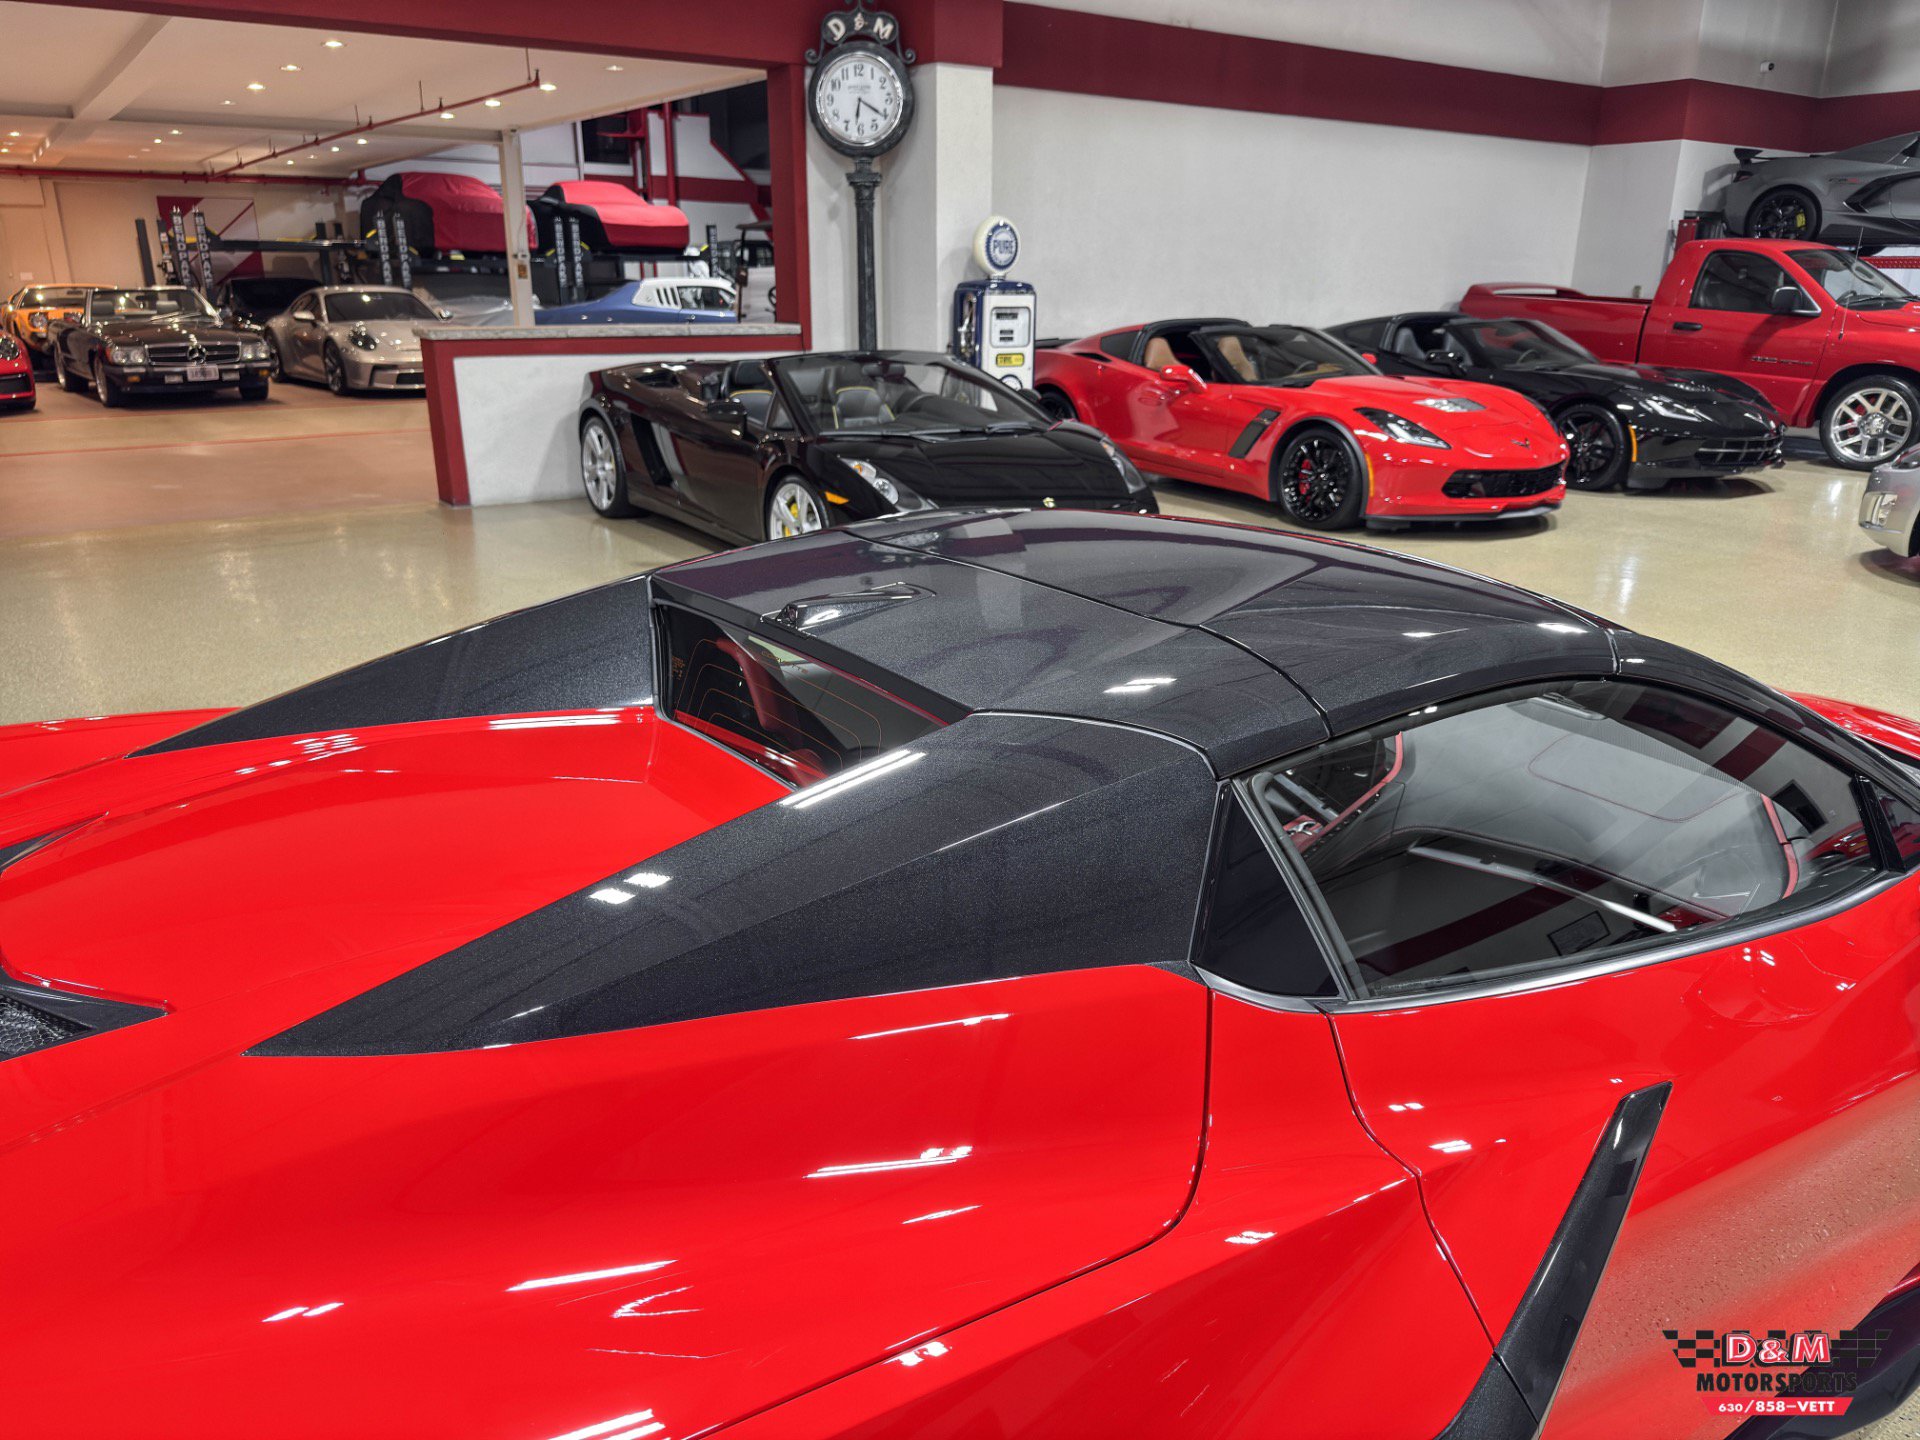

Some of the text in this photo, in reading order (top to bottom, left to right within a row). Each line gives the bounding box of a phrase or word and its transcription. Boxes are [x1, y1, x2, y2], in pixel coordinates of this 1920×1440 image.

[841, 67, 849, 80] 11
[854, 64, 864, 77] 12
[831, 79, 841, 91] 10
[879, 77, 887, 89] 2
[827, 94, 834, 107] 9
[885, 93, 893, 105] 3
[832, 109, 840, 121] 8
[881, 108, 889, 120] 4
[844, 120, 850, 132] 7
[857, 123, 865, 136] 6
[871, 119, 878, 131] 5
[993, 239, 1014, 254] PURE
